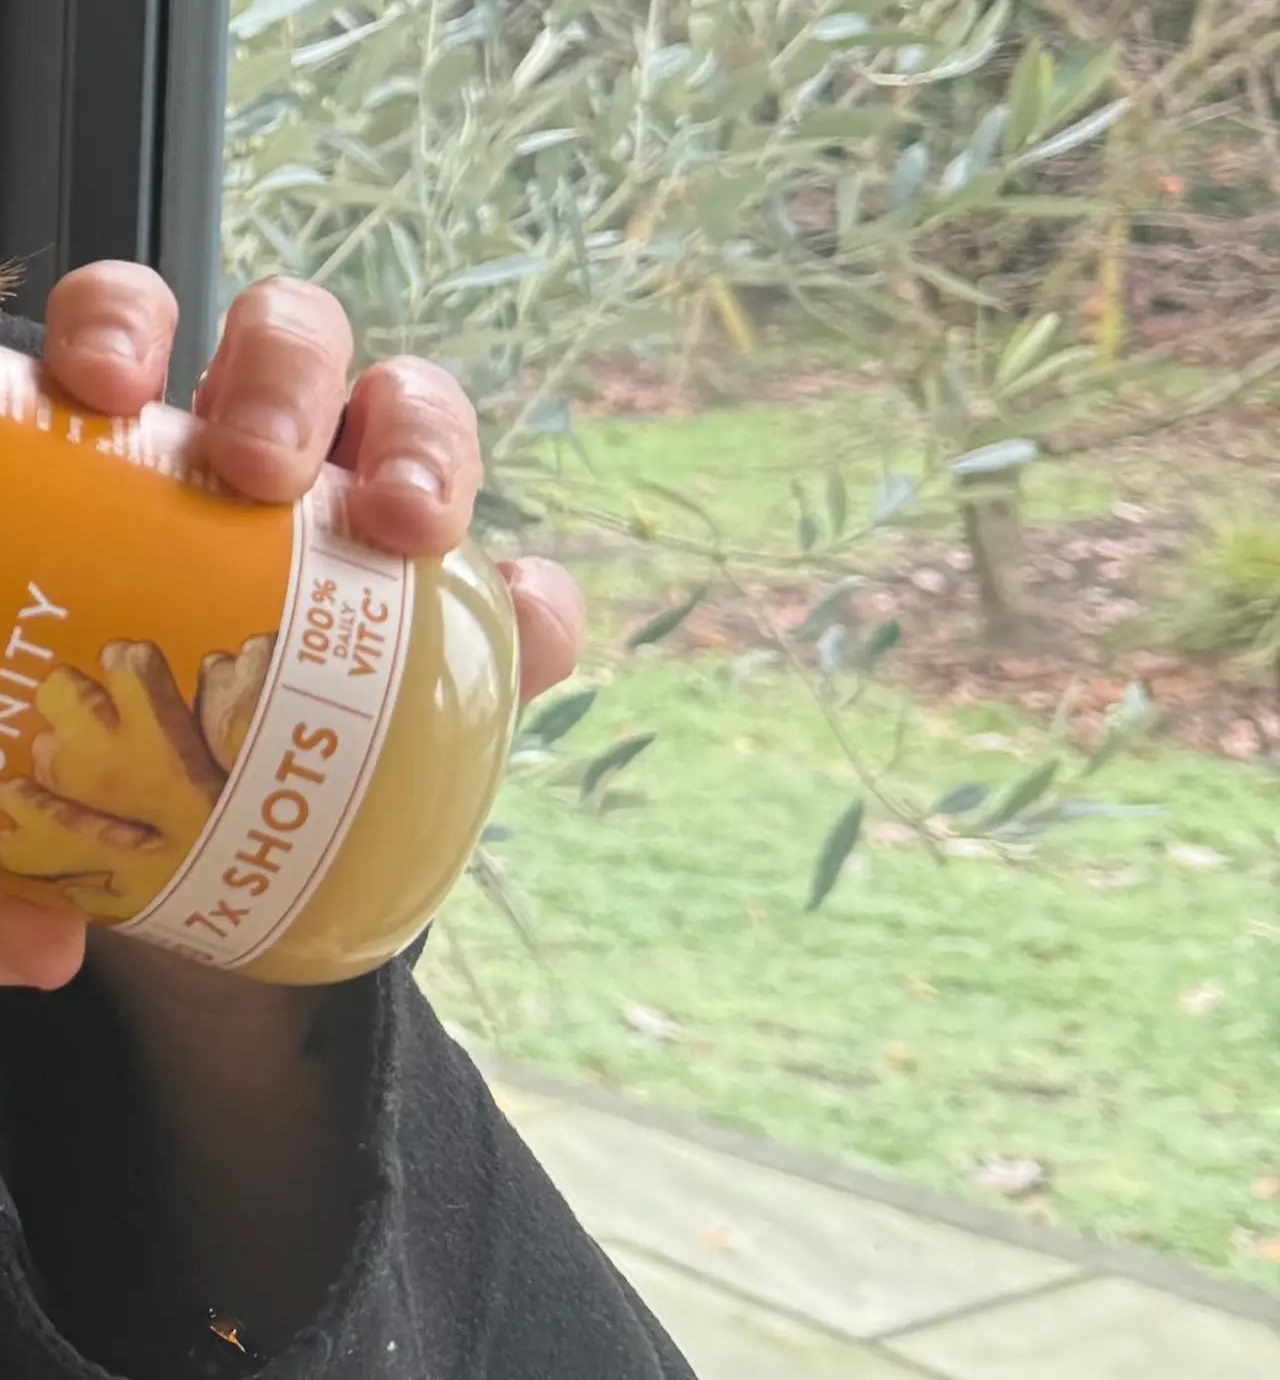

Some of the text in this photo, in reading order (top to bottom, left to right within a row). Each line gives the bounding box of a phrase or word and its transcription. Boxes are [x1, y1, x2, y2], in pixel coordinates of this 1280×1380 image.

[297, 577, 337, 666] 100%
[332, 601, 357, 661] DAILY
[183, 721, 339, 940] 7x SHOTS
